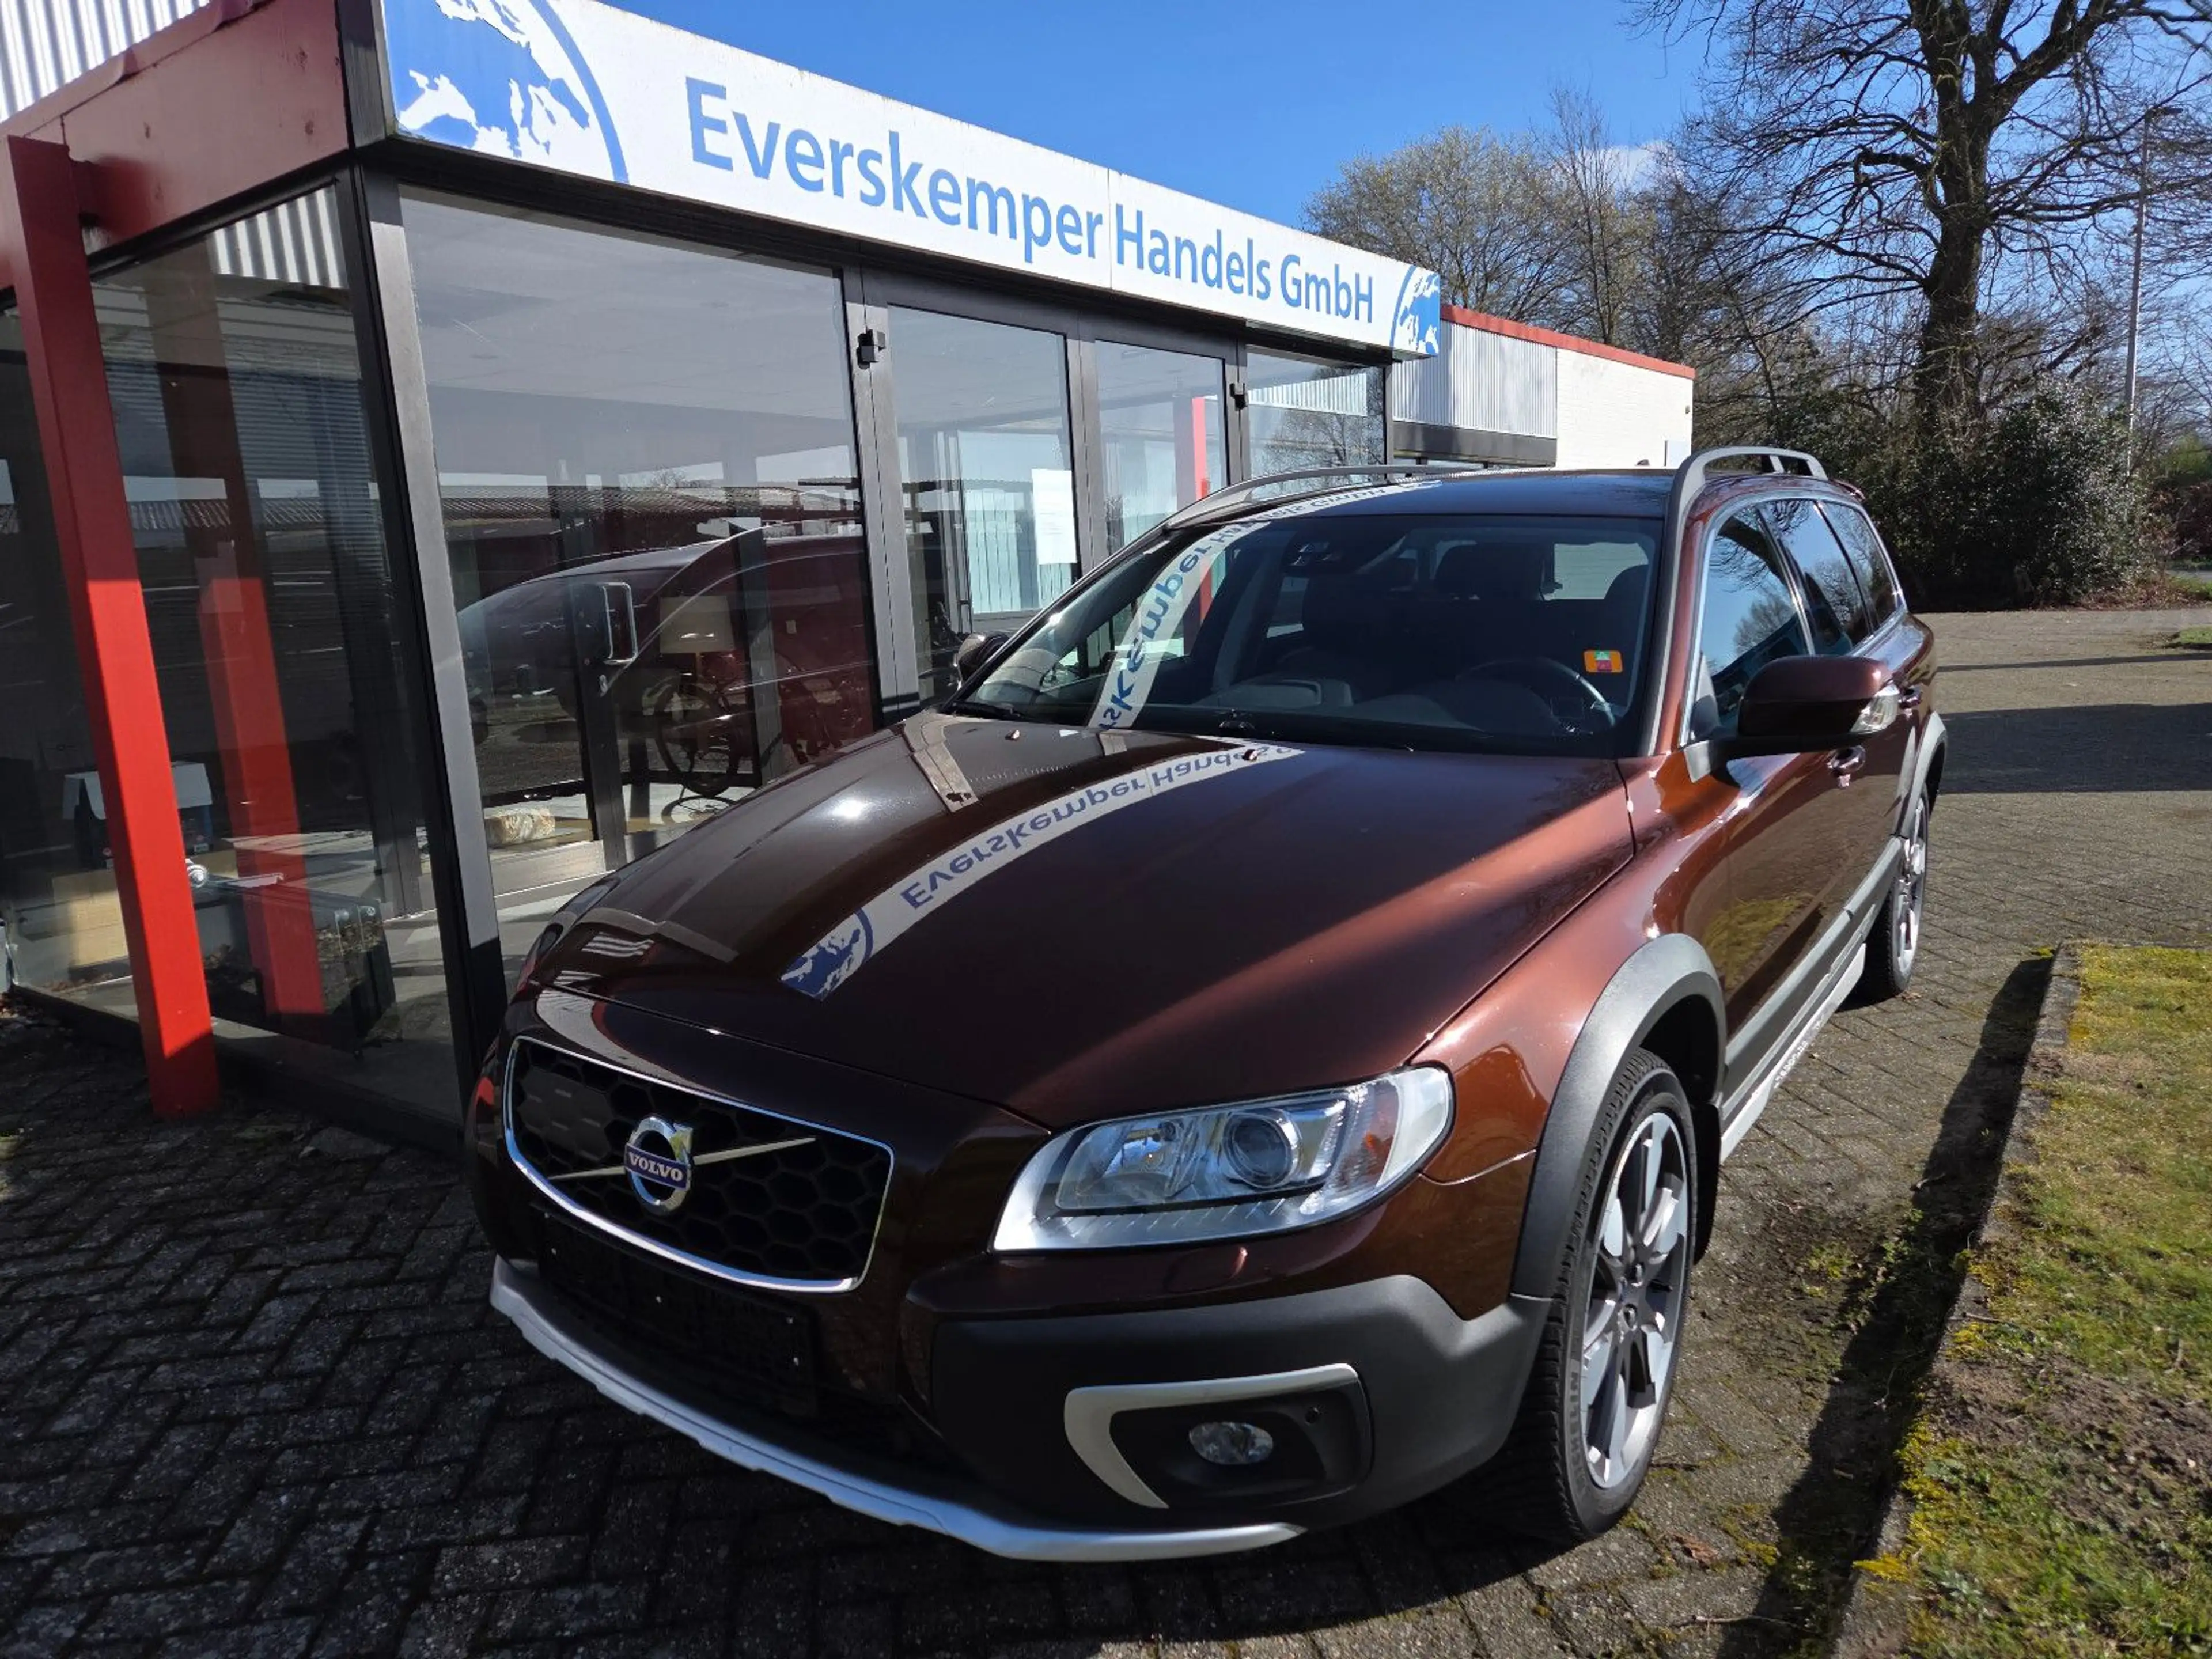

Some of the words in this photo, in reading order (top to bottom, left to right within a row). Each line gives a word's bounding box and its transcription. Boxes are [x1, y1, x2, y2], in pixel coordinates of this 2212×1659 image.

[685, 75, 1103, 264] Everskemper
[1115, 203, 1271, 300] Handels
[1280, 253, 1373, 323] GmbH
[629, 1152, 683, 1181] VOLVO
